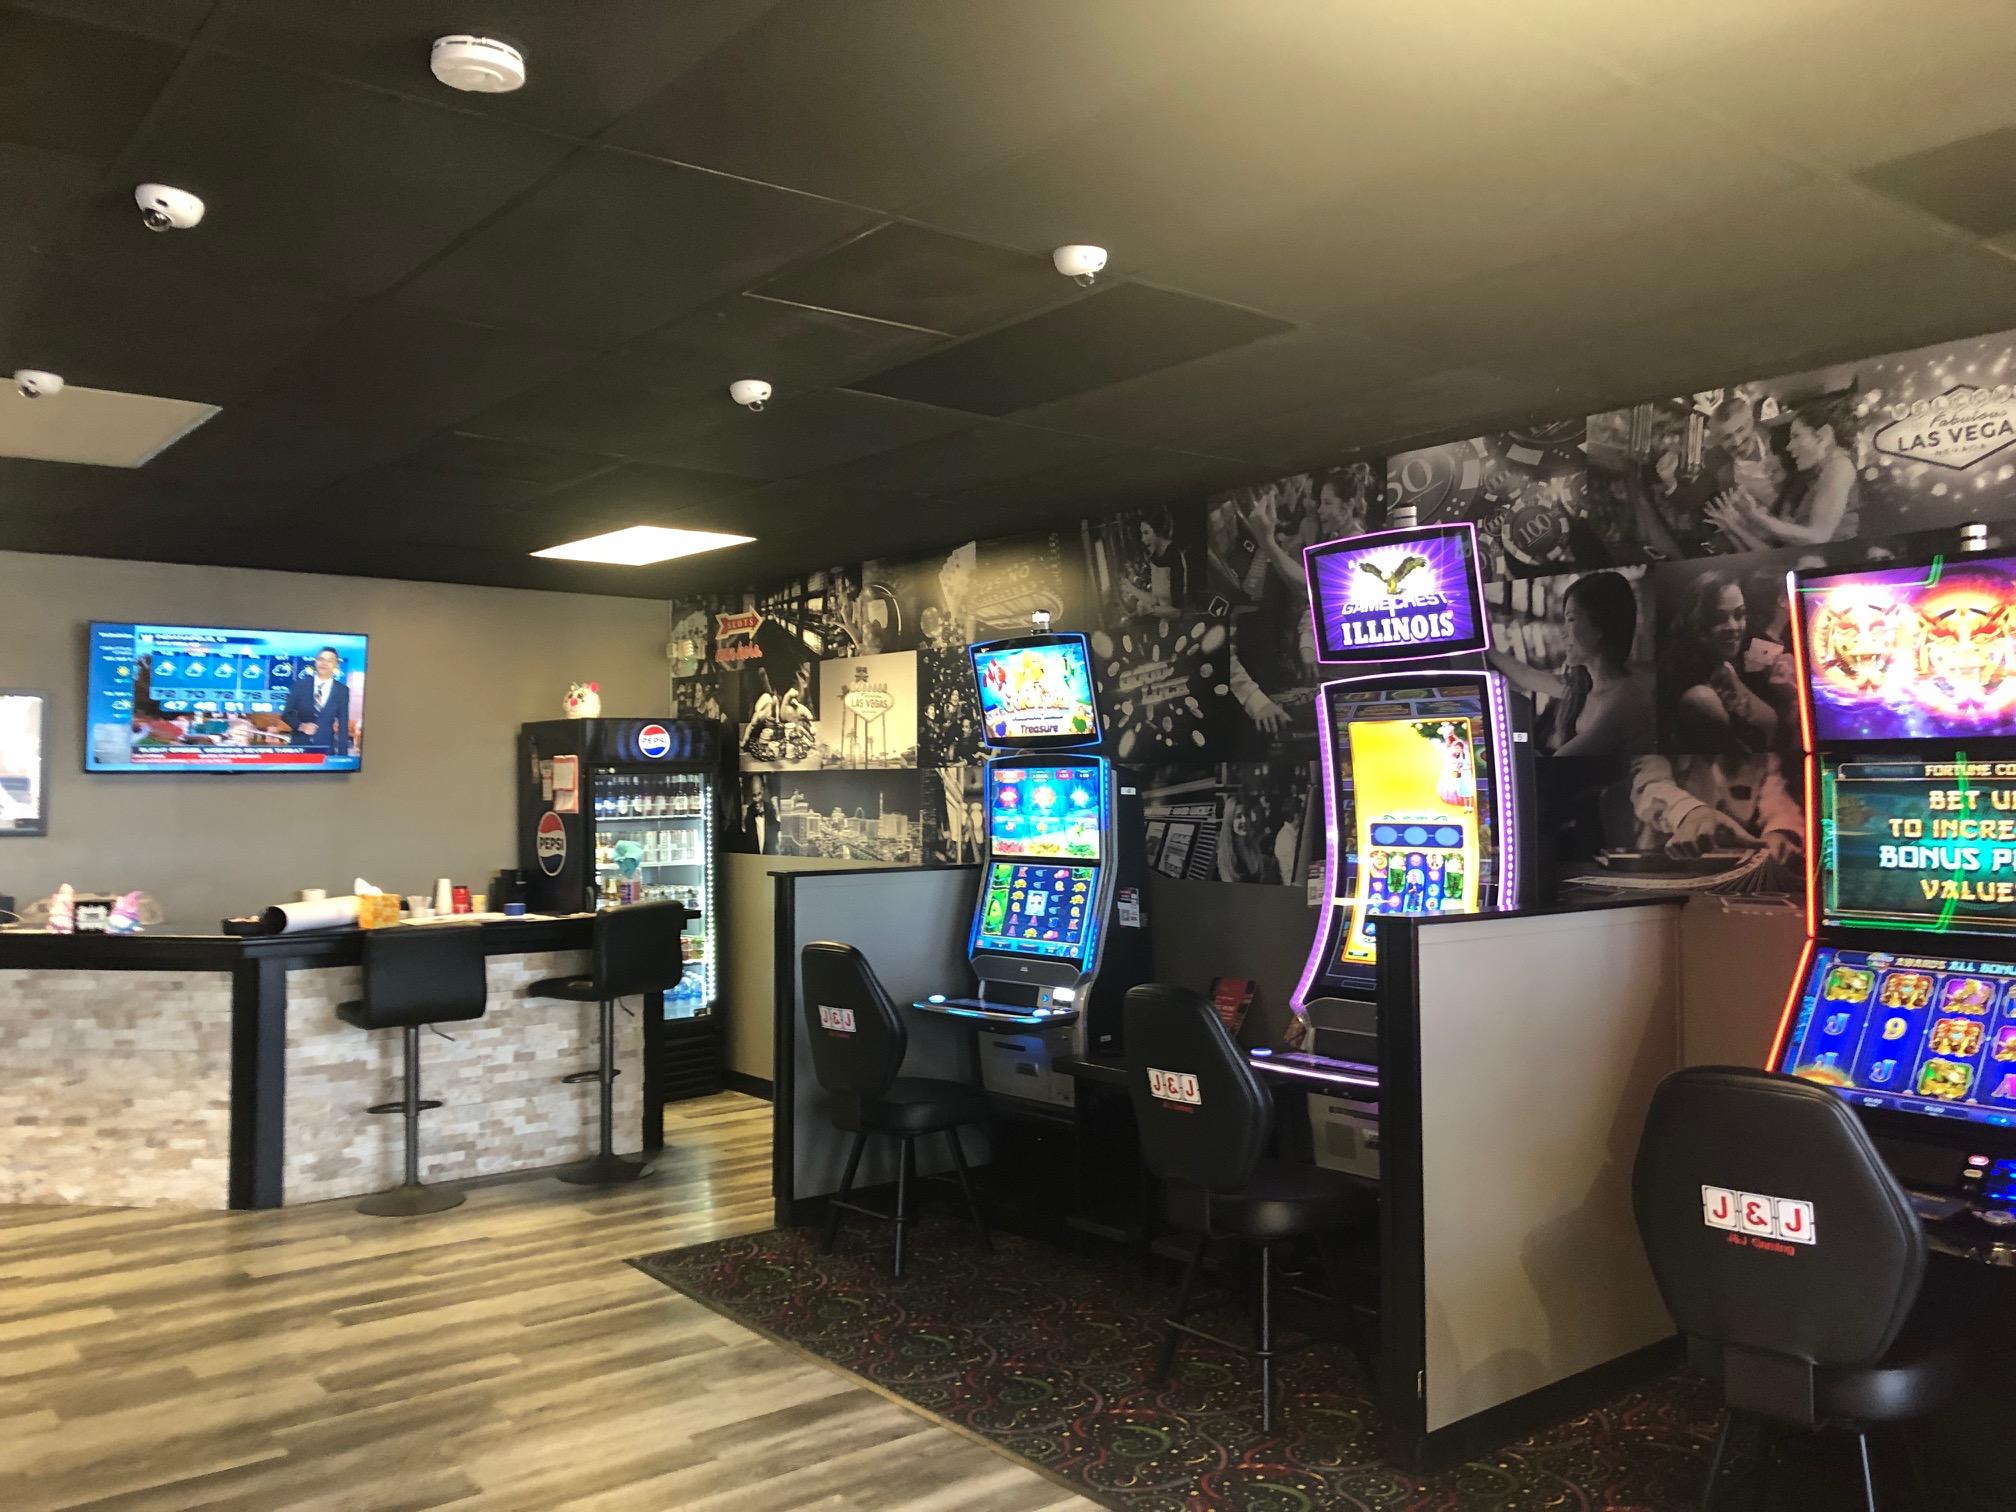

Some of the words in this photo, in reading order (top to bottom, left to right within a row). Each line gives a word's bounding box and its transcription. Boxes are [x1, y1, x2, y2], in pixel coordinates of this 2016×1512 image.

[1929, 411, 2007, 428] Fabulous
[1898, 431, 1940, 452] LAS
[1947, 419, 2015, 443] VEGA
[1520, 513, 1552, 543] 100
[1341, 612, 1456, 646] ILLINOIS
[1020, 724, 1059, 735] Treasure
[1924, 764, 1992, 777] FORTUNE
[1929, 790, 1981, 811] BET
[1888, 818, 1923, 838] TO
[539, 836, 564, 850] PEPSI
[1879, 845, 1981, 870] BONUS
[1948, 961, 1975, 972] ALL
[1882, 1017, 1907, 1040] 9
